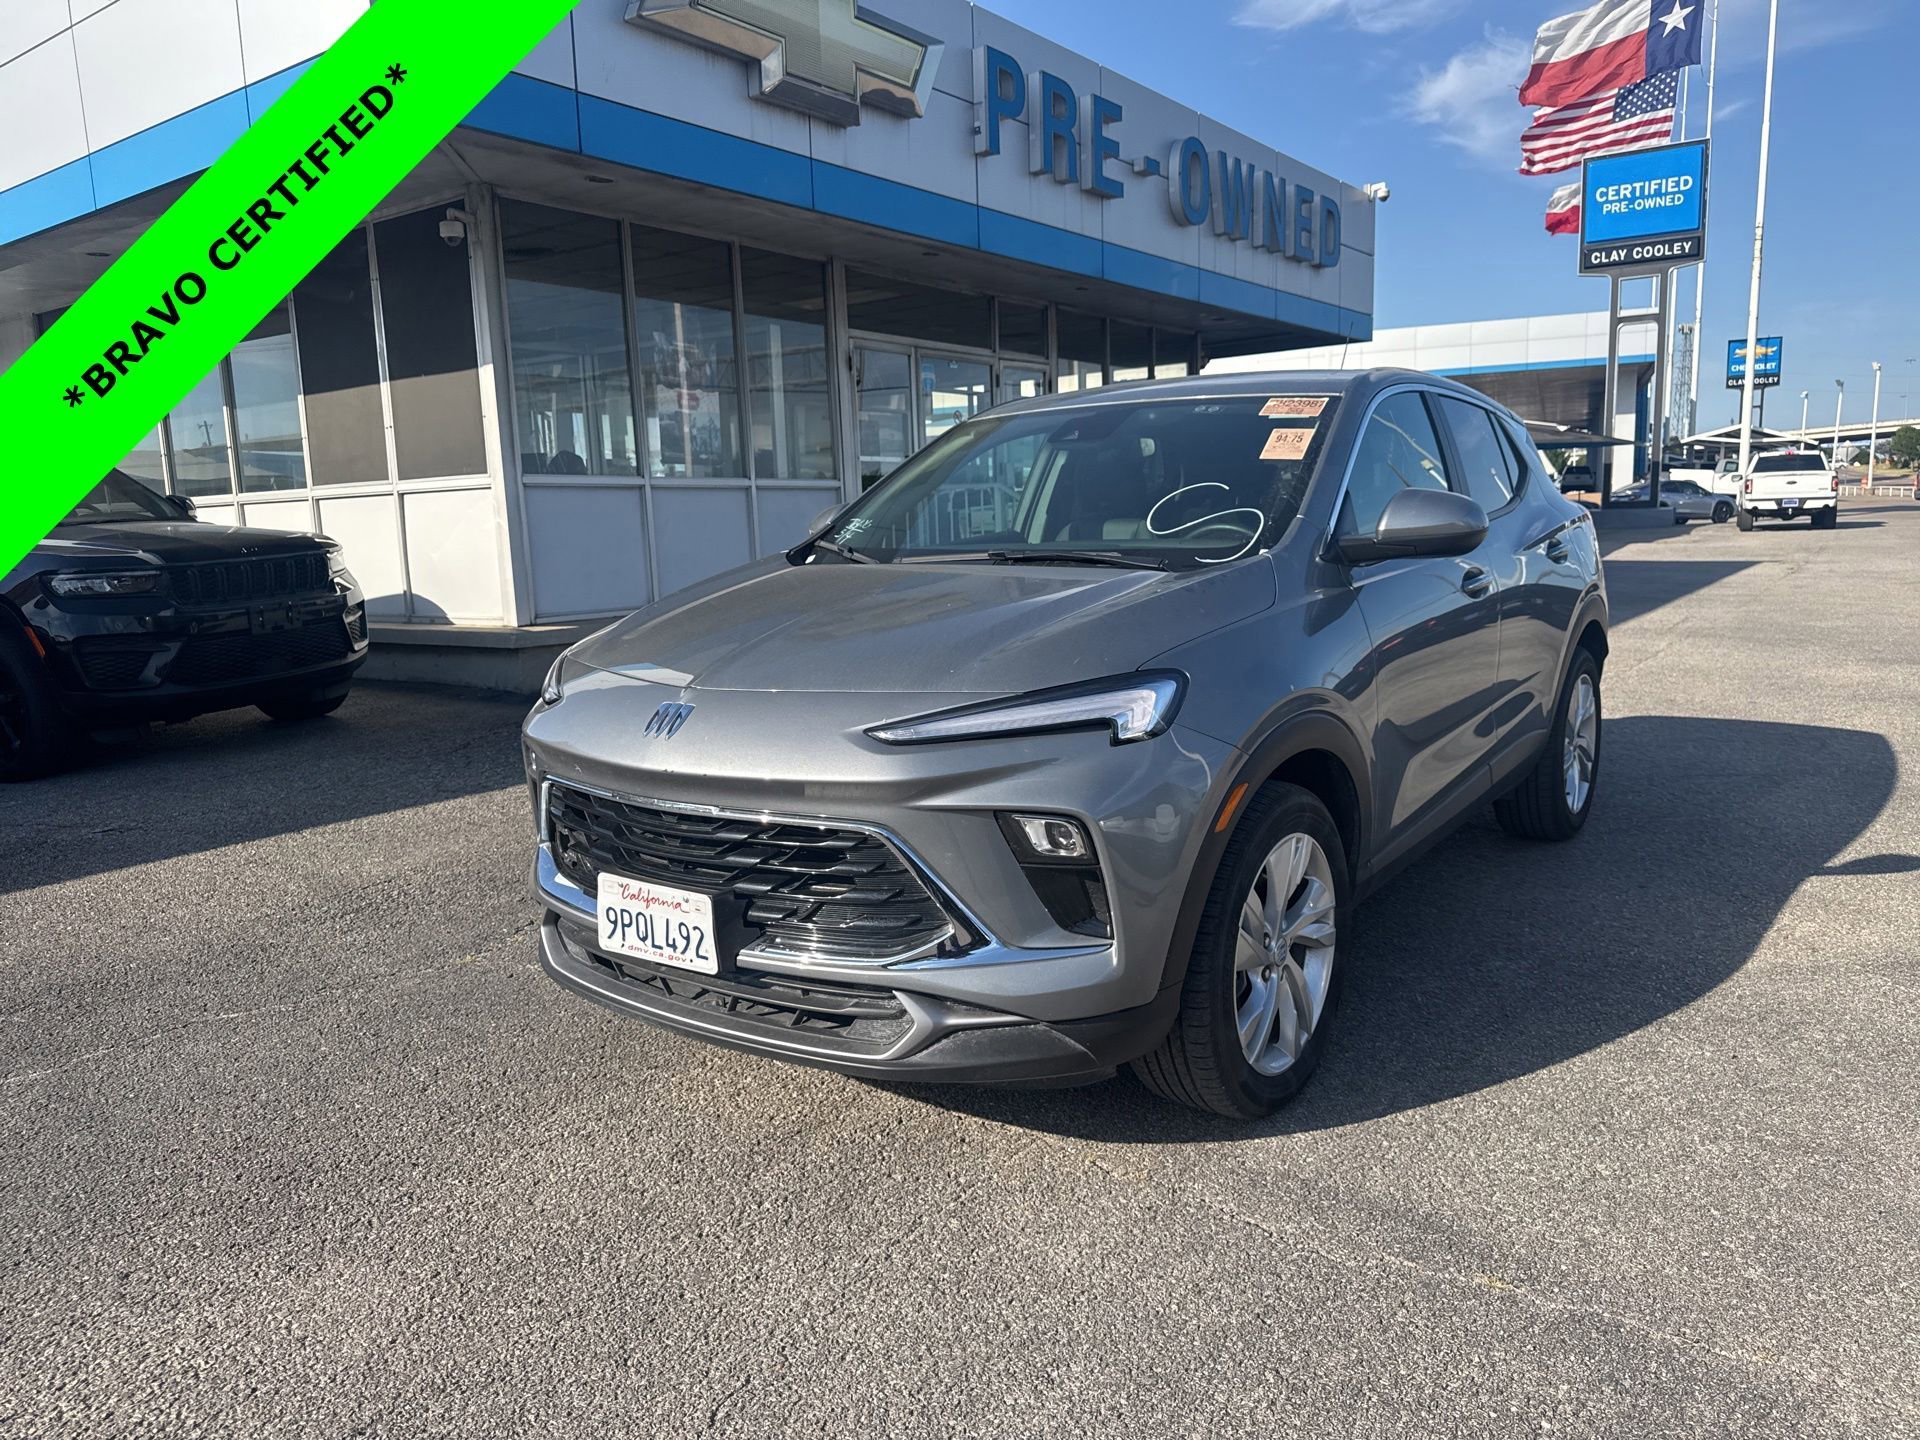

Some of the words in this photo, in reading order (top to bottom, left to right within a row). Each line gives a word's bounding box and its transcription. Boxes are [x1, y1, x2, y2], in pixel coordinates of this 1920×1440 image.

[973, 45, 1341, 268] PRE-OWNED
[1595, 175, 1693, 202] CERTIFIED
[1602, 194, 1684, 215] PRE-OWNED
[1591, 249, 1627, 264] CLAY
[1632, 241, 1692, 259] COOLEY
[1752, 376, 1778, 385] OOLEY
[621, 883, 690, 913] California
[606, 906, 709, 960] 9PQL492
[628, 944, 687, 962] dmv.ca.gov
